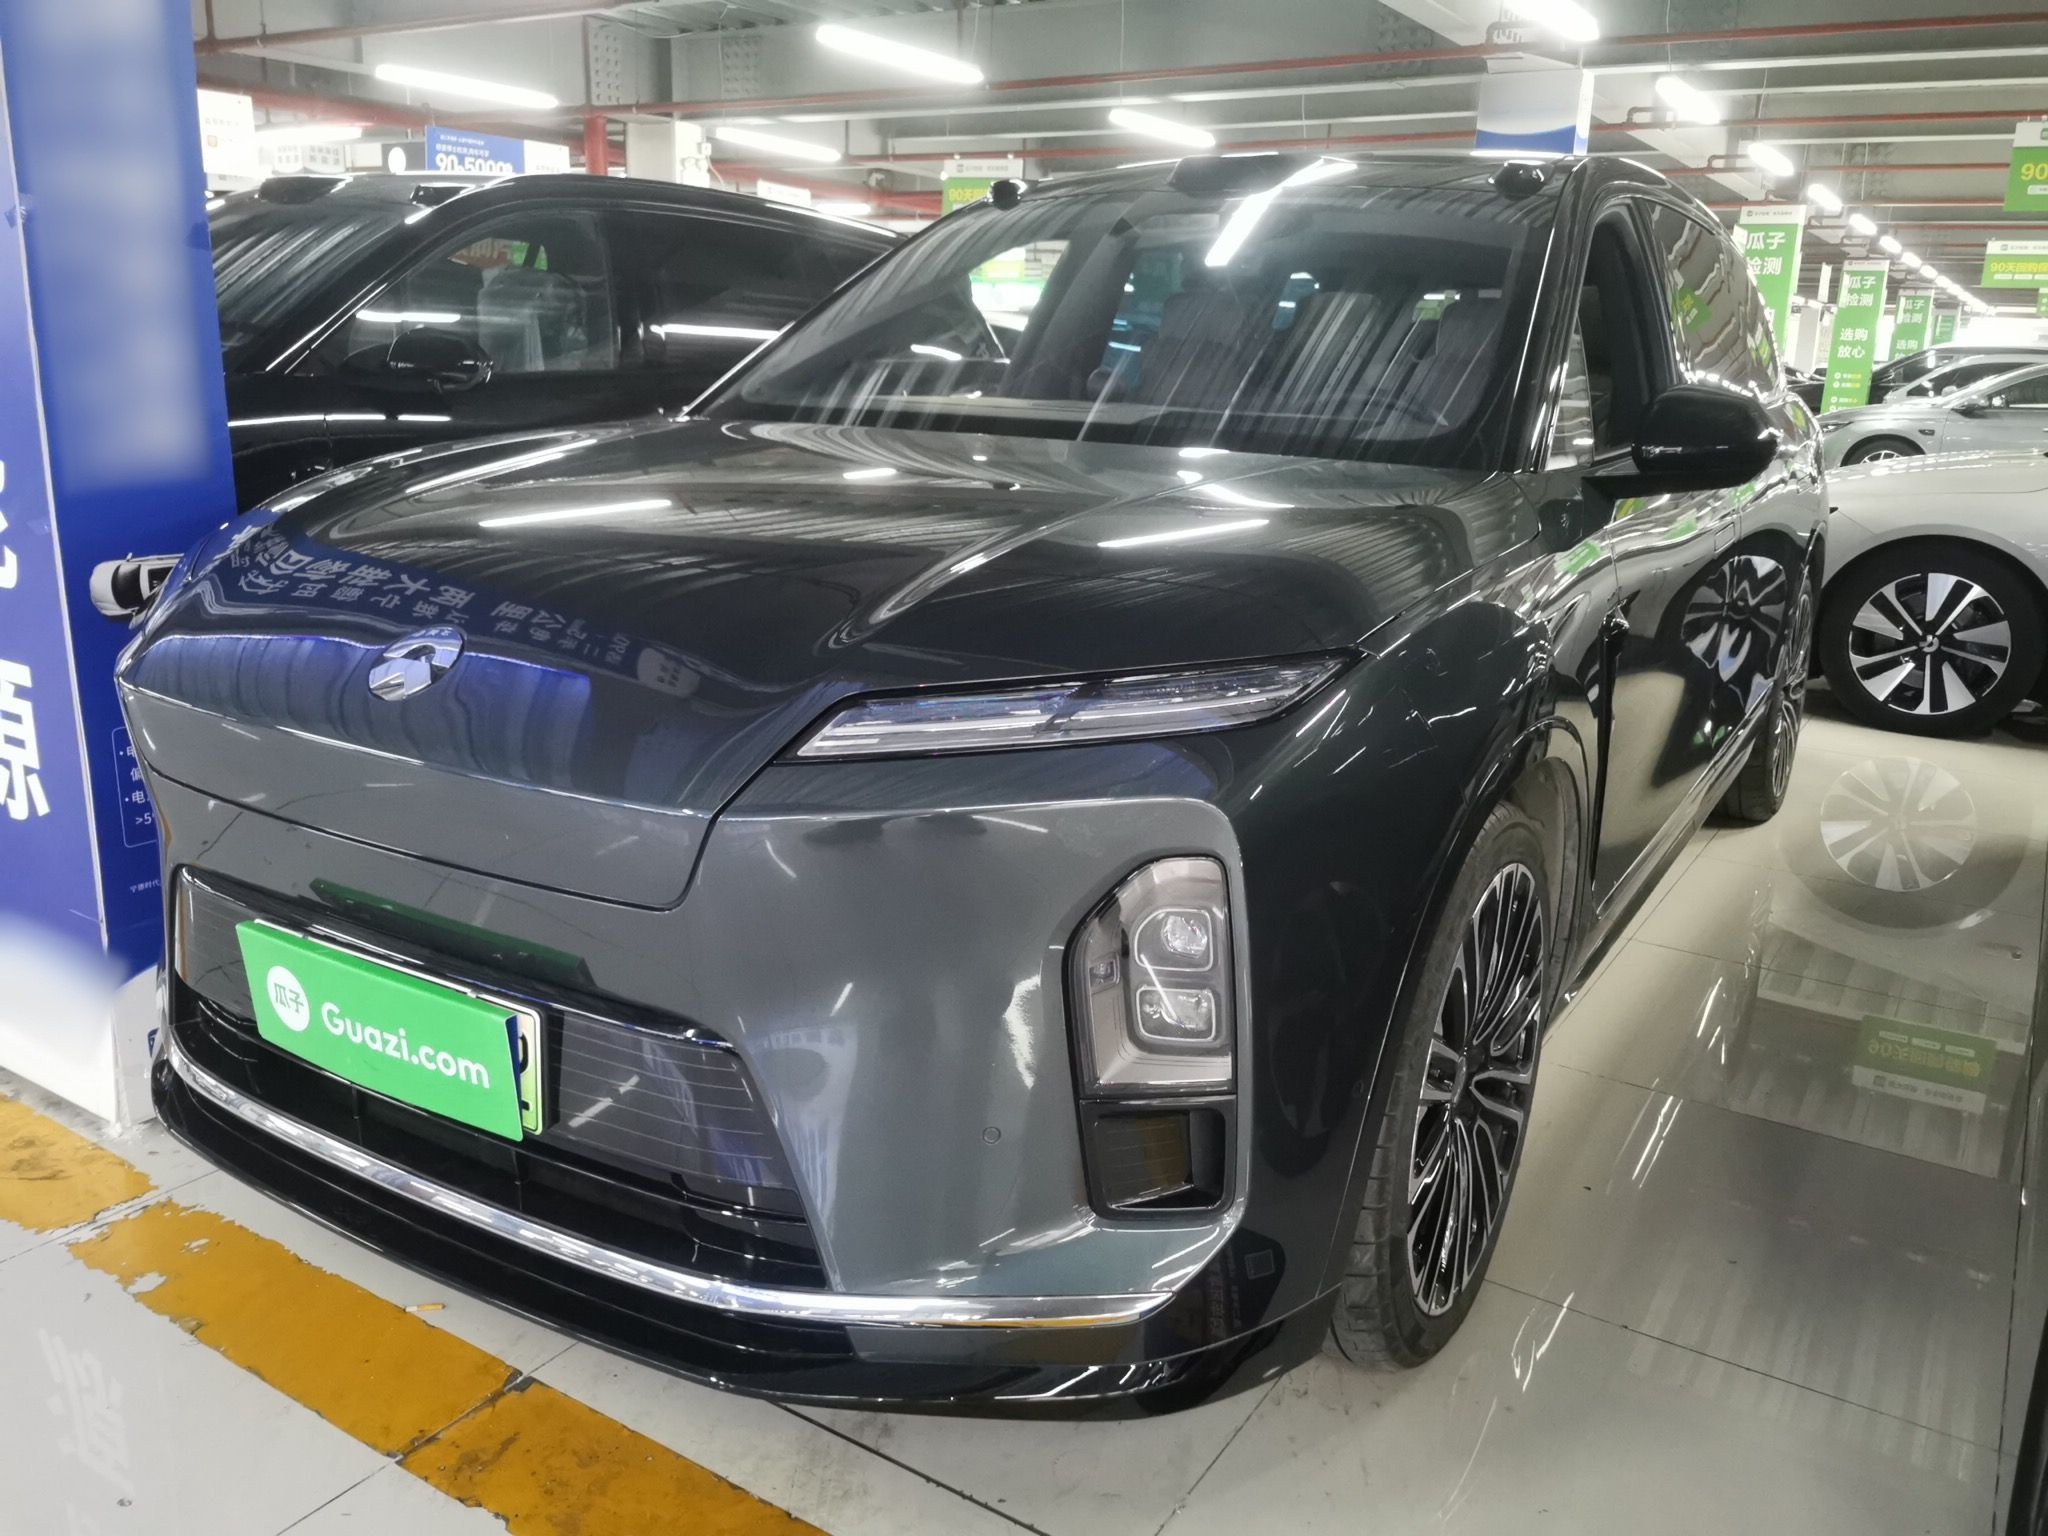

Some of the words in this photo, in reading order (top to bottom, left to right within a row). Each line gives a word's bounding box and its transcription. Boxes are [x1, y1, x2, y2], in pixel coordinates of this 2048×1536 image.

[1746, 231, 1786, 250] 瓜子
[1746, 256, 1783, 276] 检测
[1848, 275, 1877, 289] 瓜子
[1839, 327, 1869, 342] 选购
[1837, 345, 1866, 359] 放心
[135, 811, 156, 826] >5
[272, 981, 305, 1014] 瓜子
[321, 1001, 490, 1089] Guazi.com
